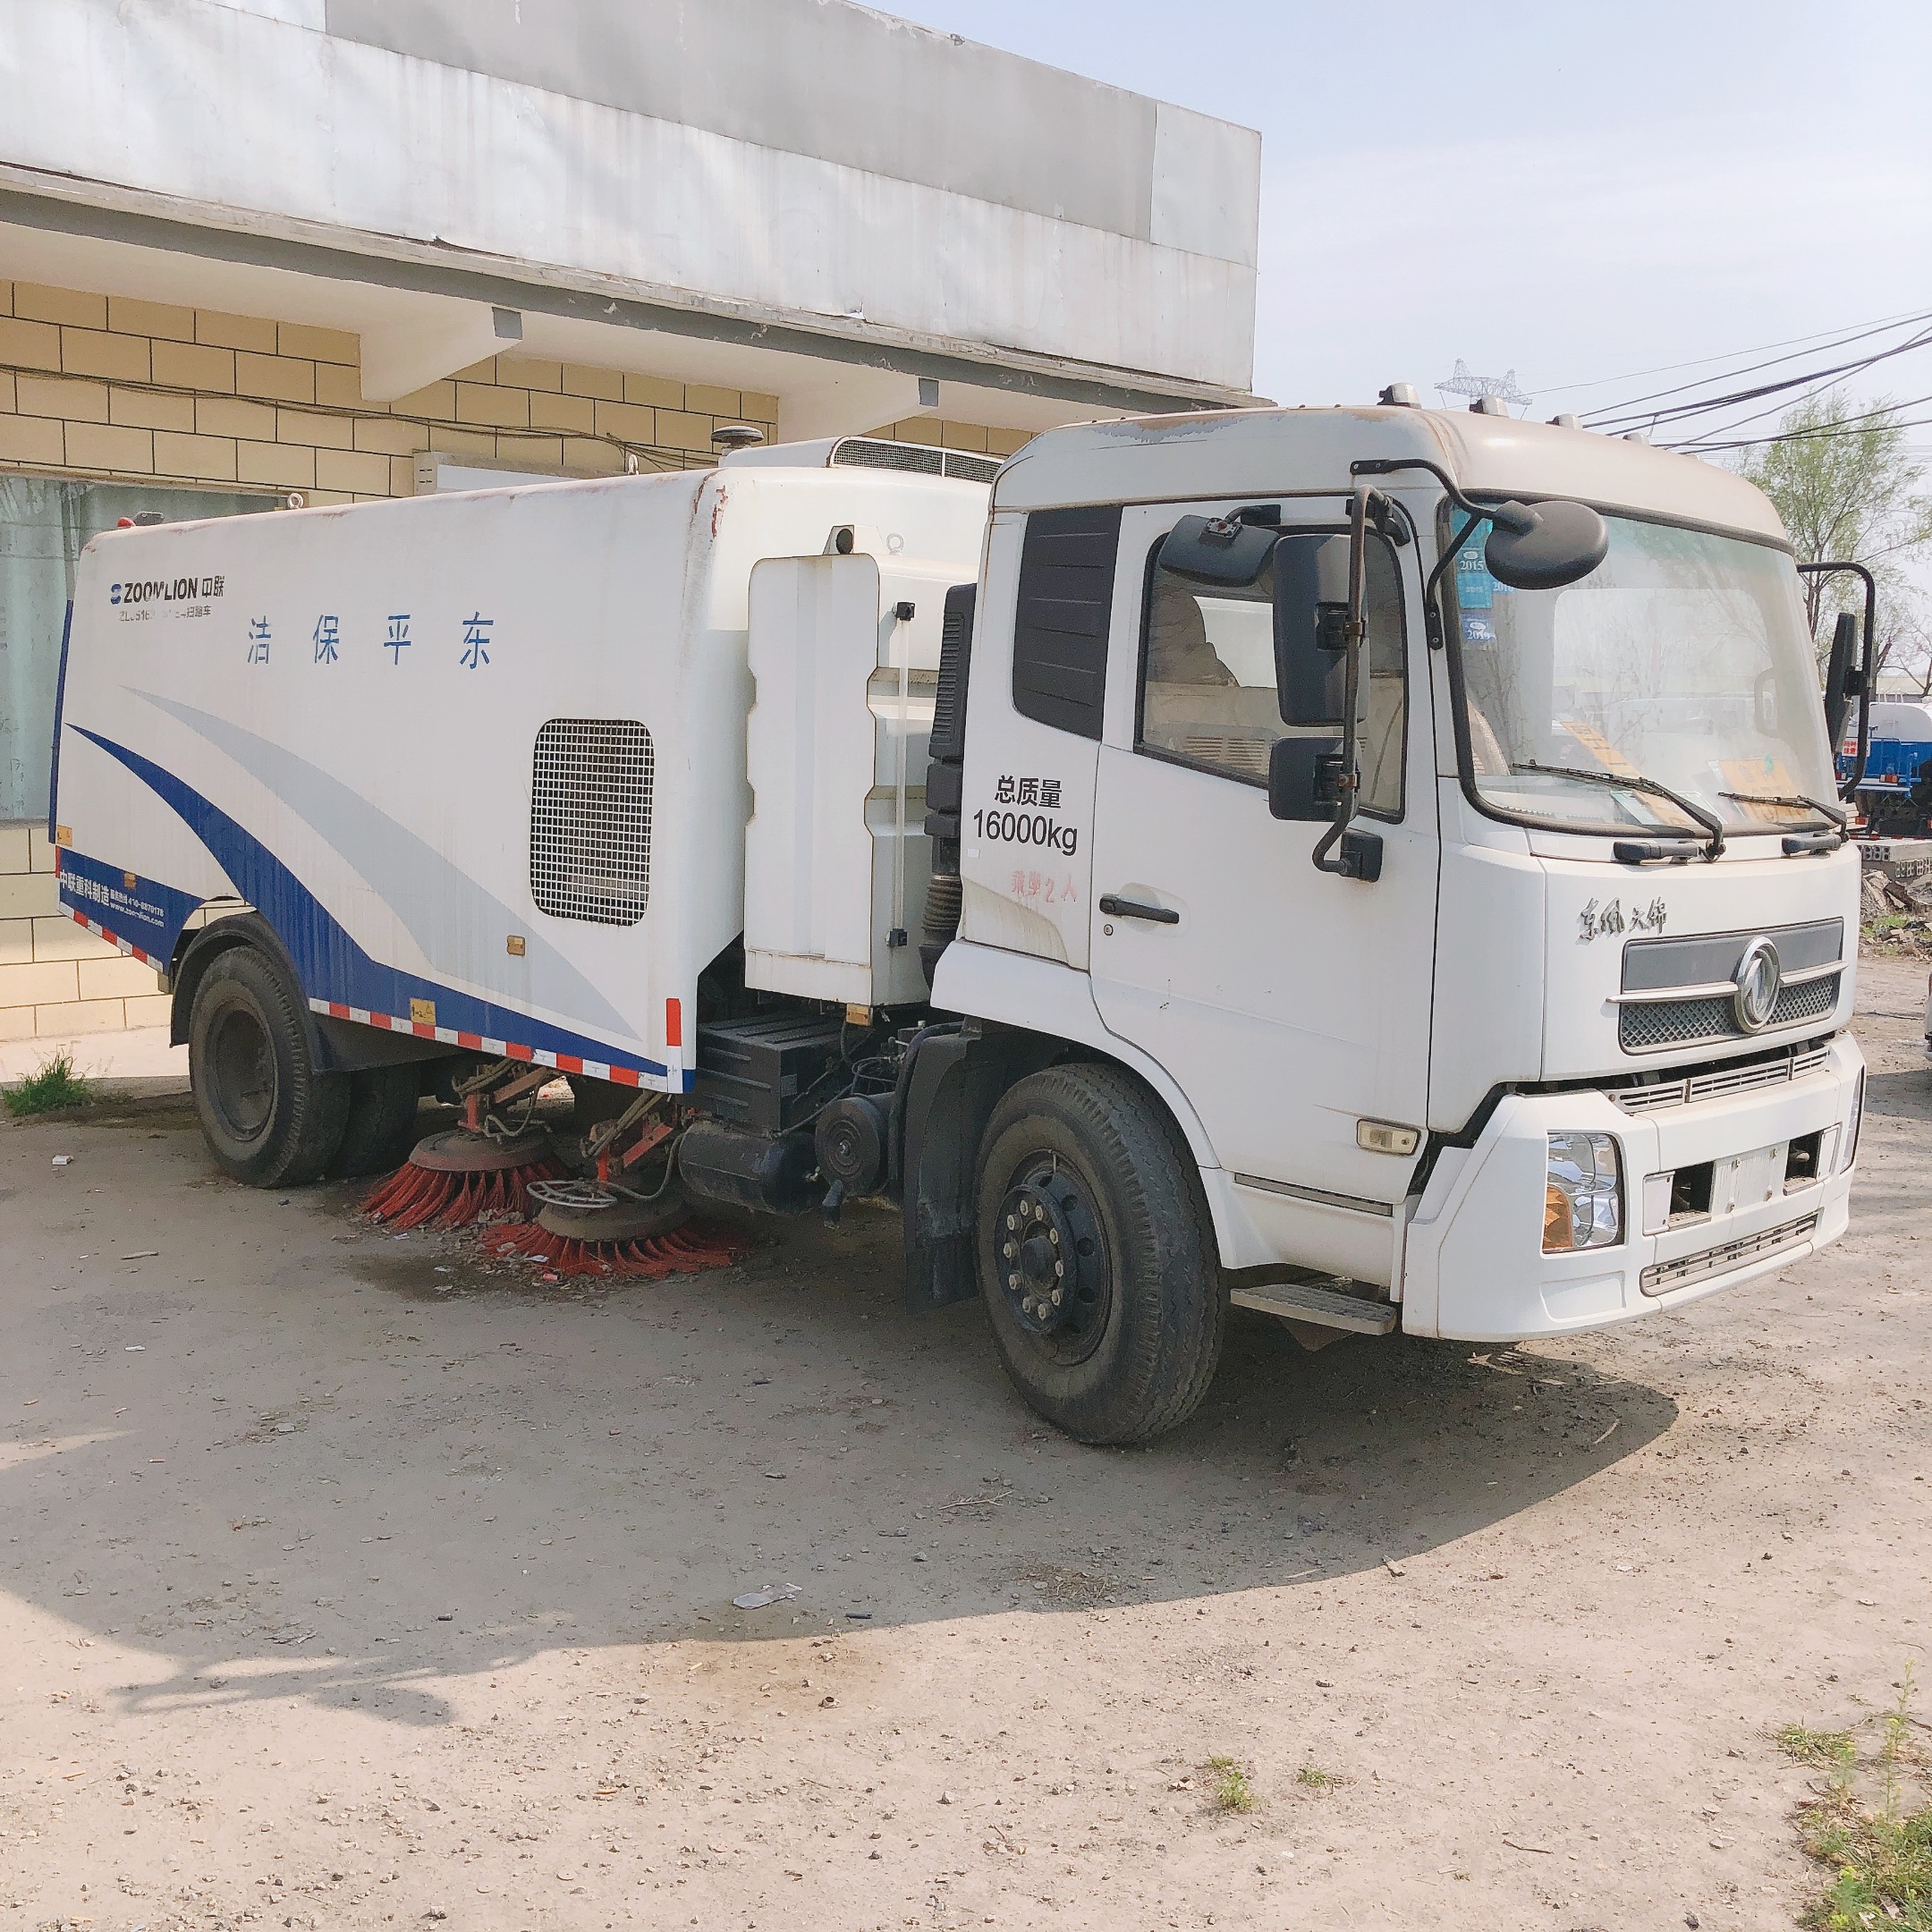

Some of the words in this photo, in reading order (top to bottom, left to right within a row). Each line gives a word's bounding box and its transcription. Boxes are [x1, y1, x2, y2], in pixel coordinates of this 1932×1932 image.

[1459, 560, 1484, 571] 2015
[124, 577, 199, 604] ZOOMLION
[202, 575, 225, 598] 中联
[995, 775, 1062, 809] 总质量
[973, 809, 1077, 856] 16000kg
[59, 869, 109, 906] 中联重科制造
